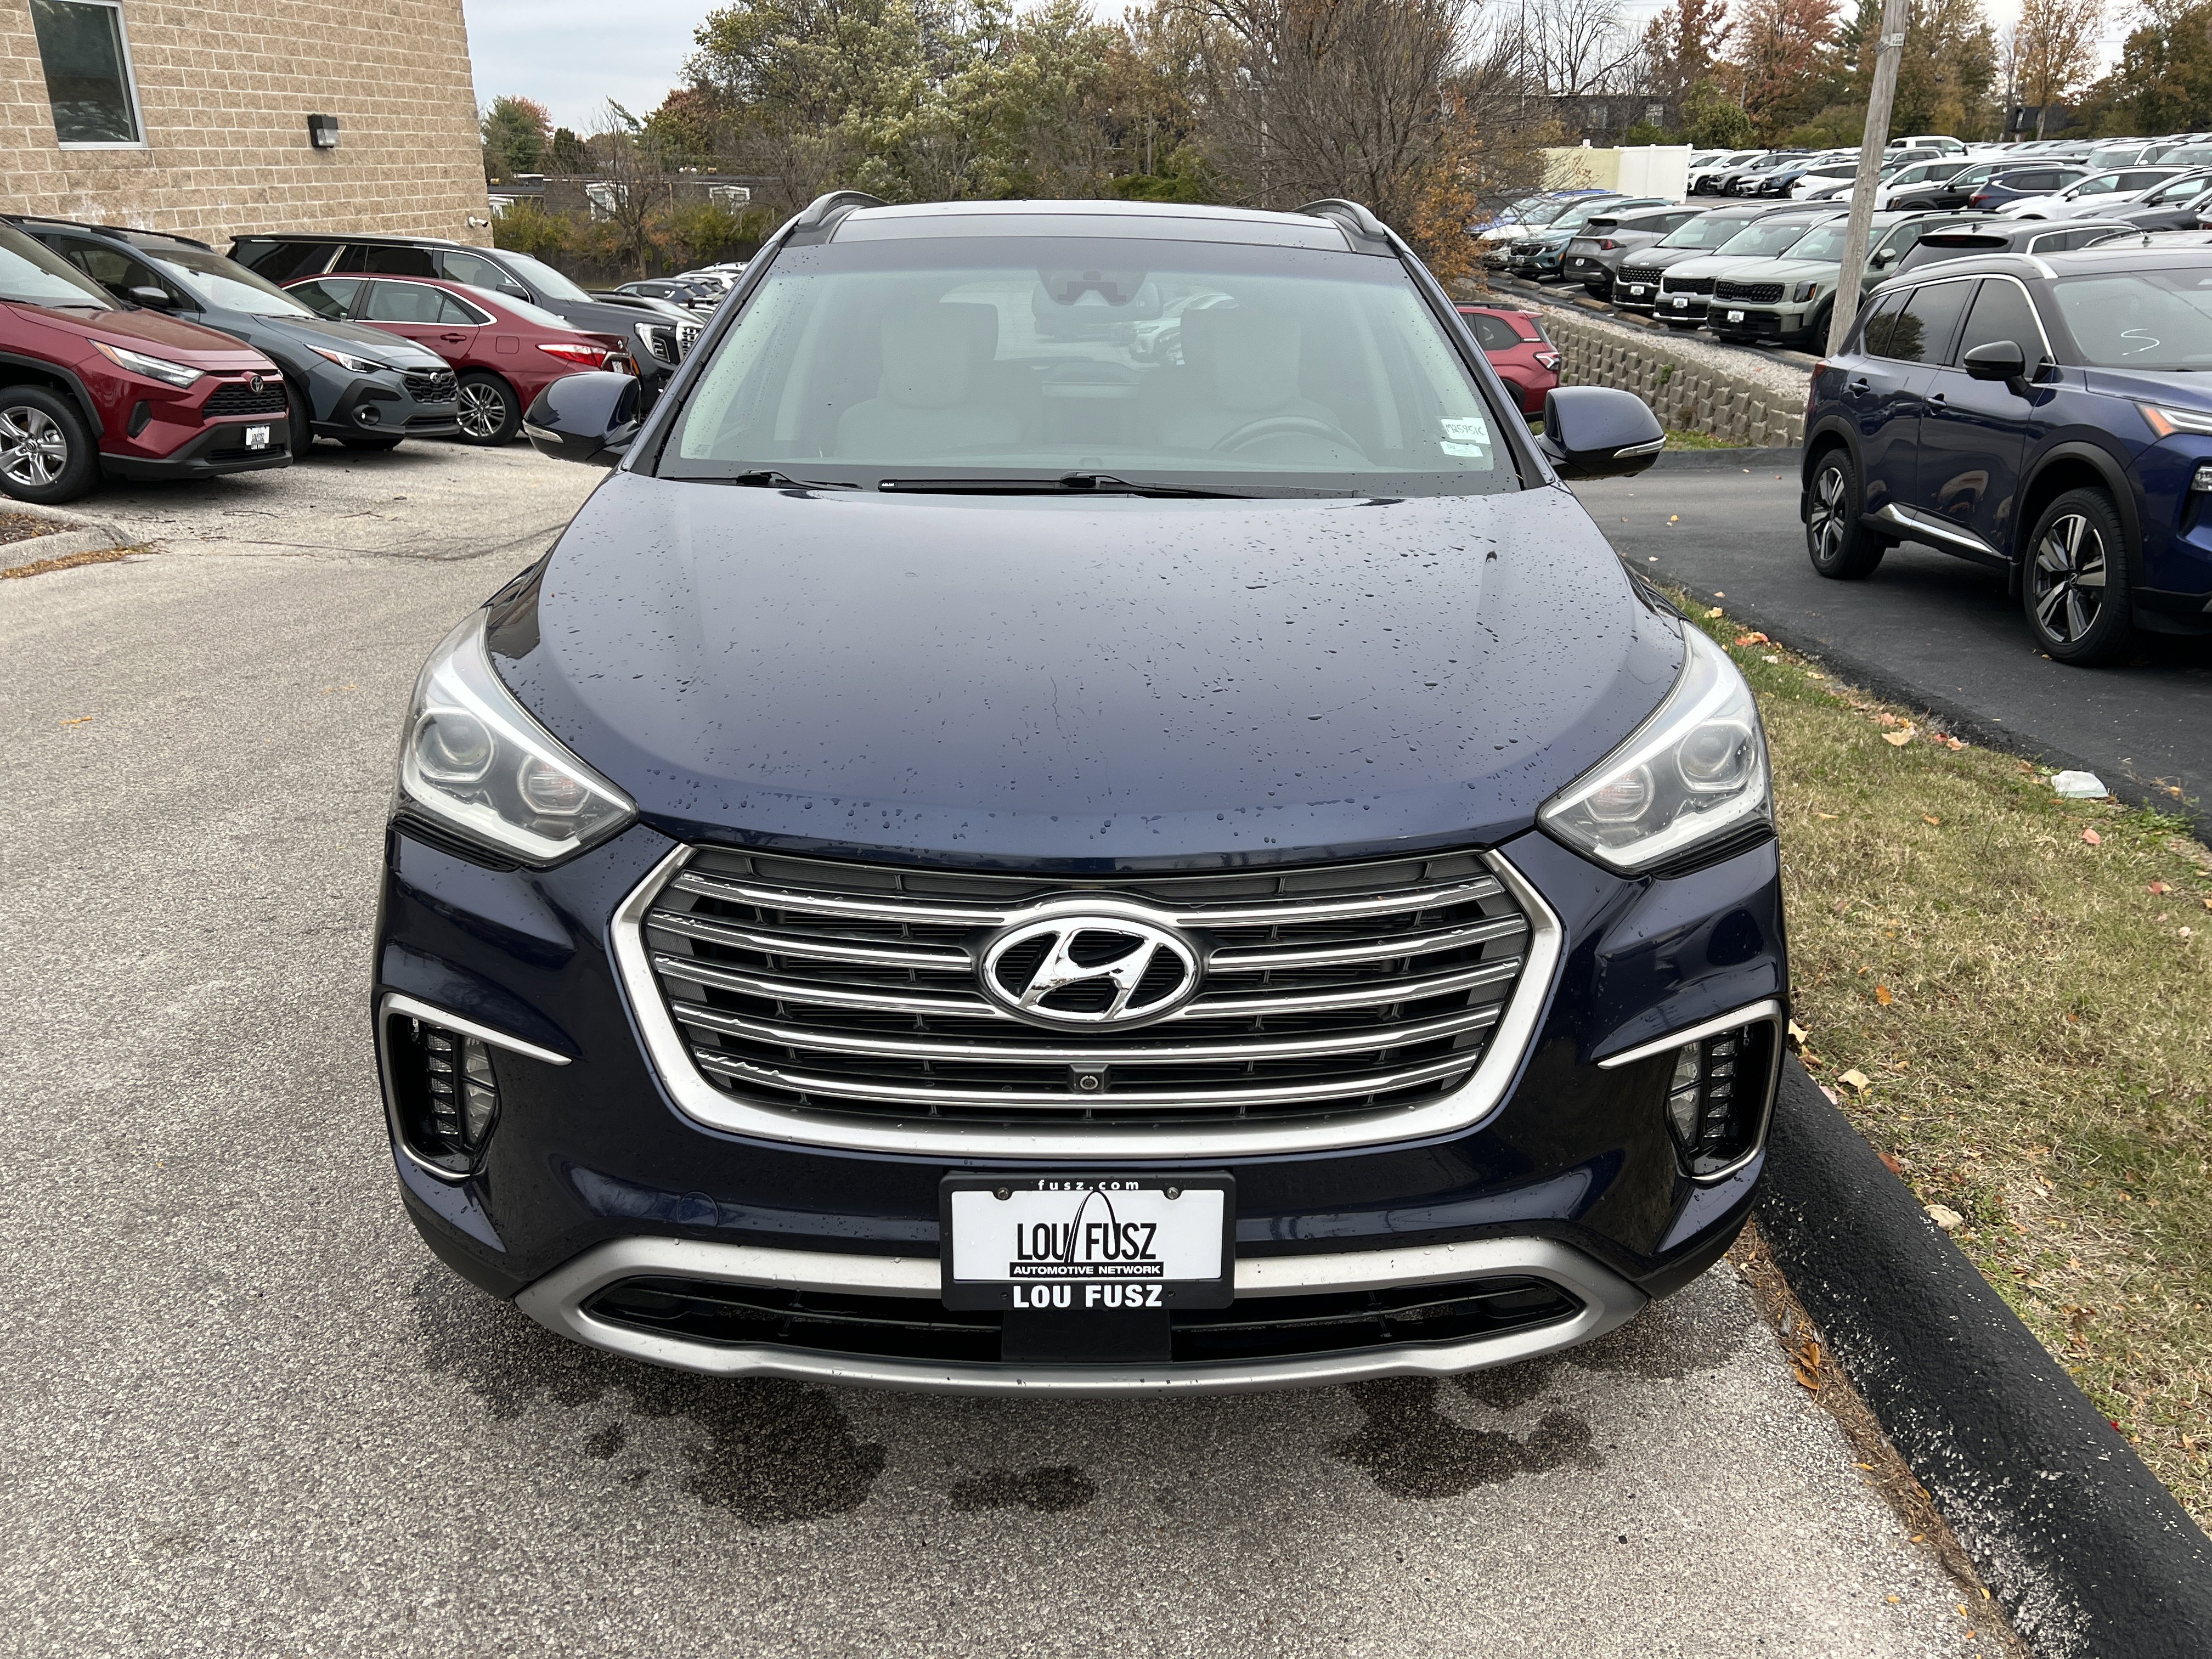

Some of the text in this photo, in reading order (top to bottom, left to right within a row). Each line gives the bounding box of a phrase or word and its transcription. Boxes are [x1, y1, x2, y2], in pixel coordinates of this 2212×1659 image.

[1038, 1179, 1139, 1190] fusz.com
[1017, 1222, 1157, 1260] LOU FUSZ
[1013, 1265, 1160, 1274] AUTOMOTIVE NETWORK
[1013, 1284, 1163, 1308] LOU FUSZ
